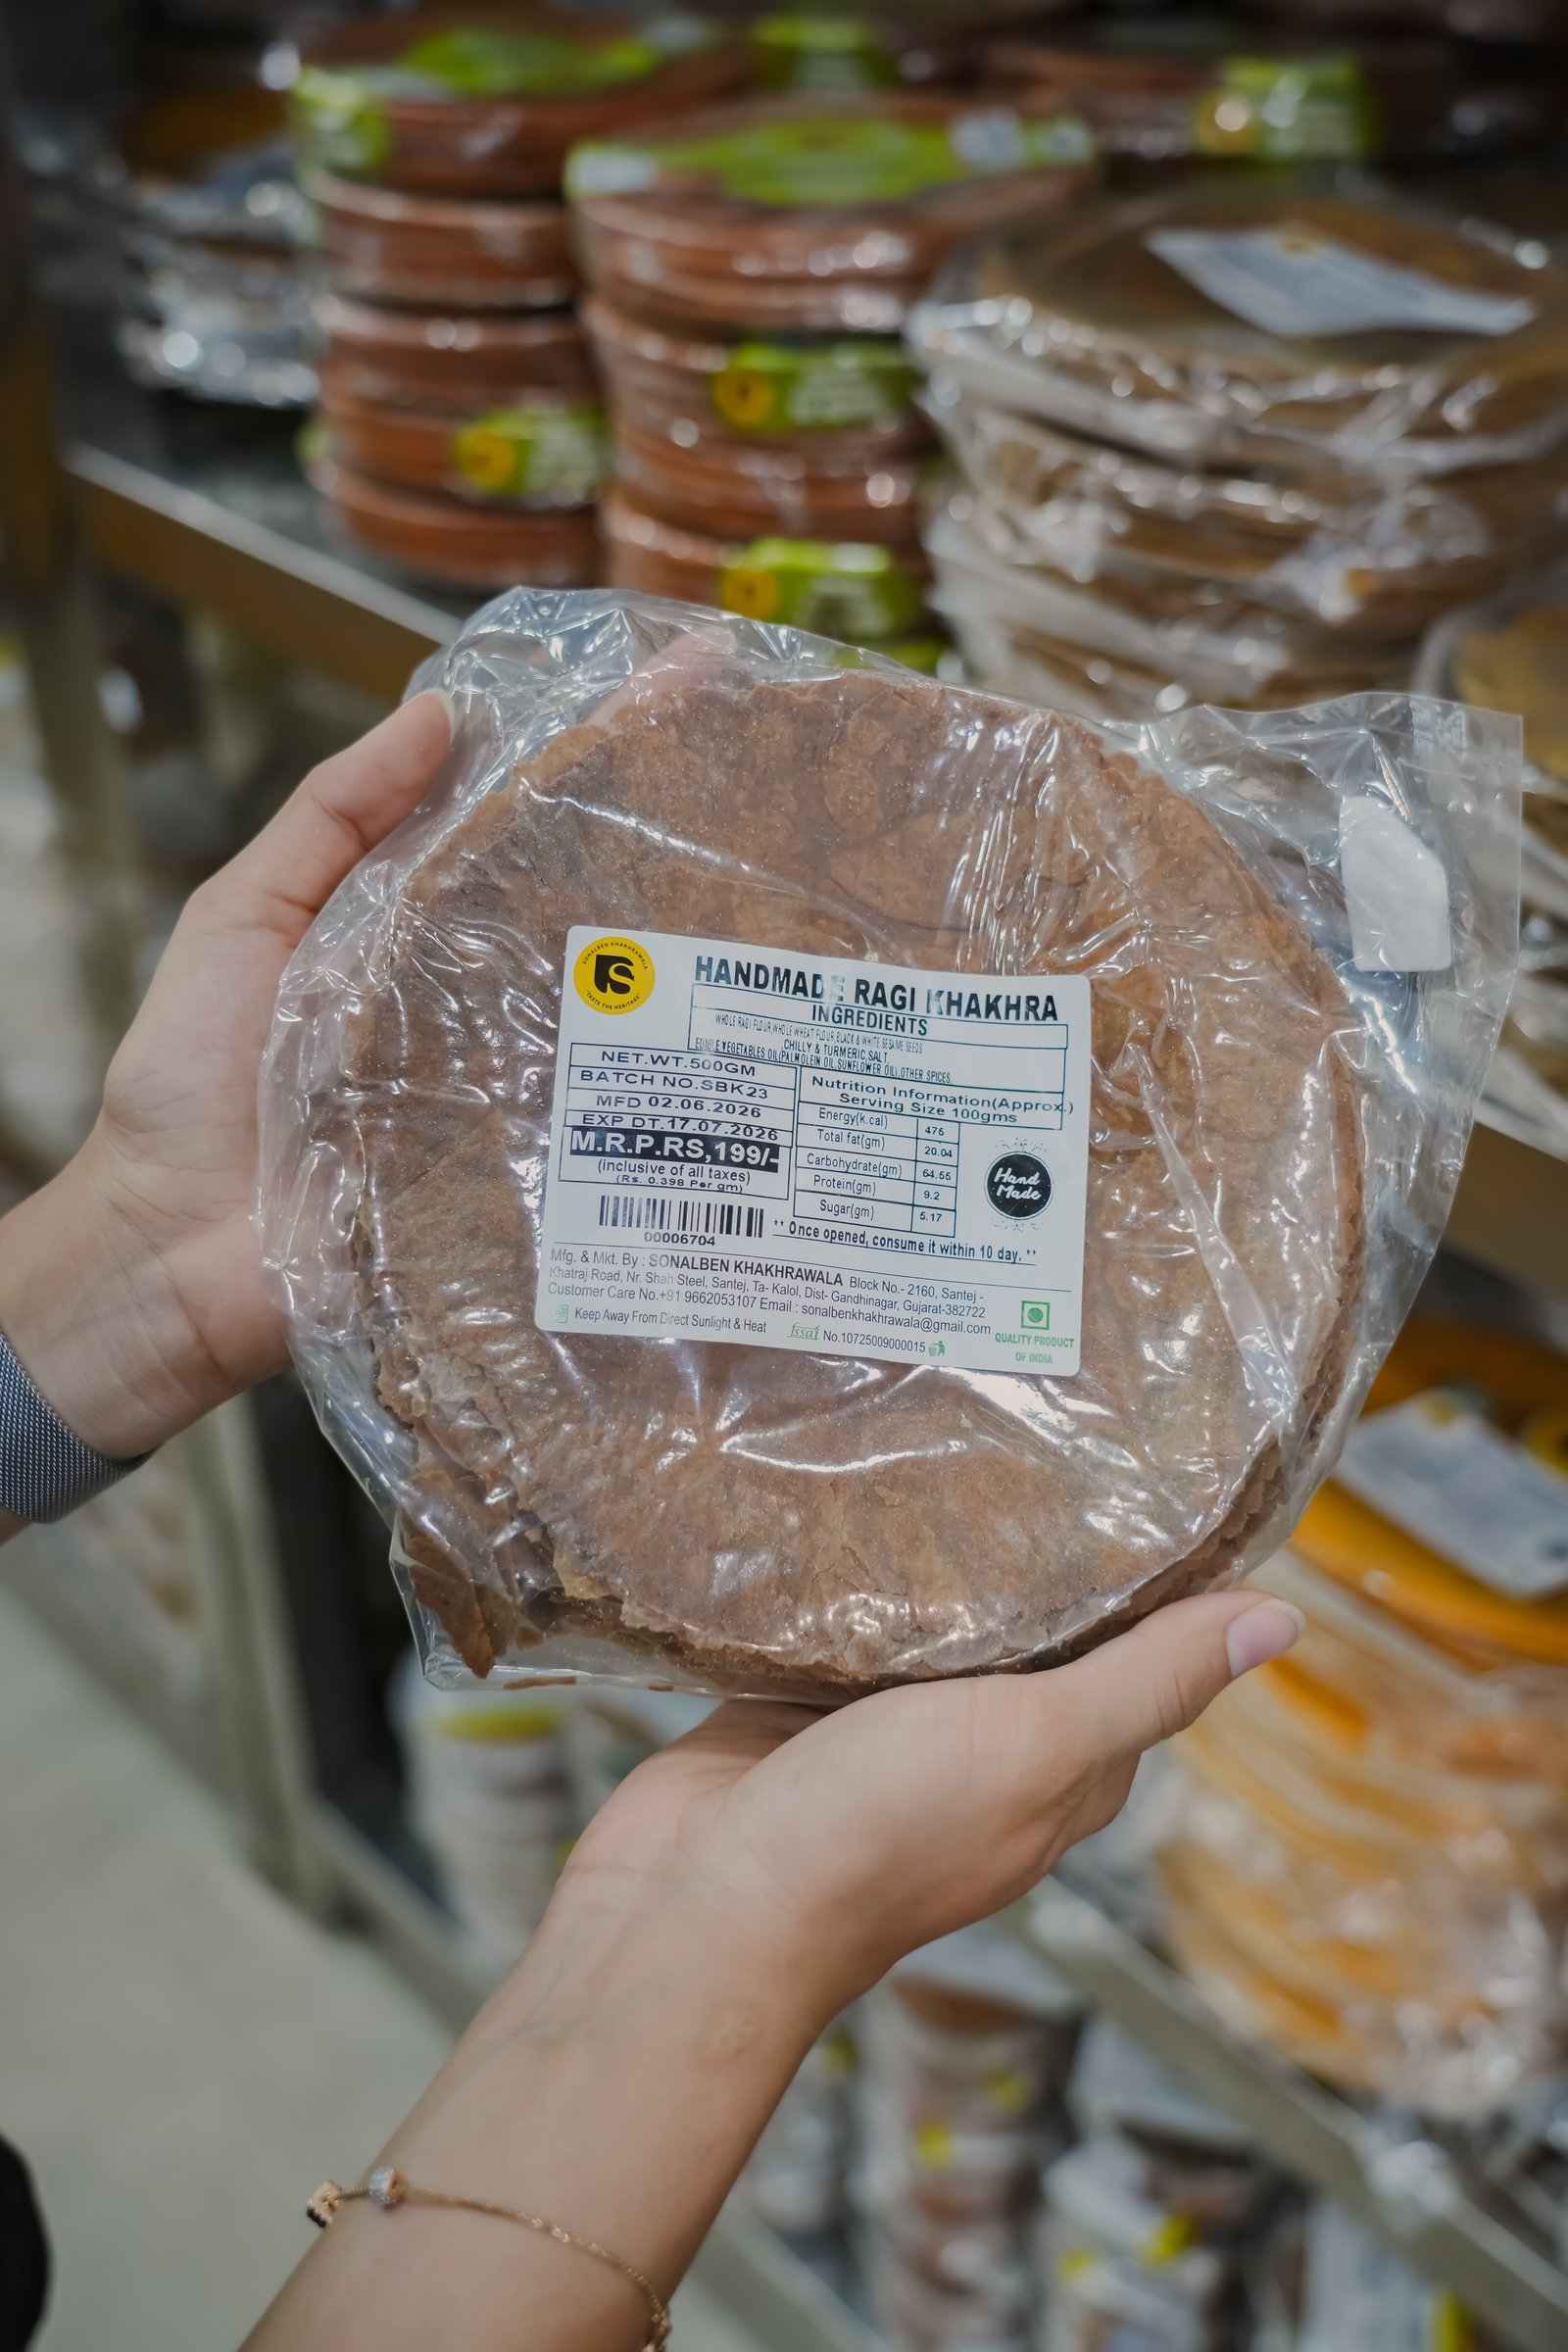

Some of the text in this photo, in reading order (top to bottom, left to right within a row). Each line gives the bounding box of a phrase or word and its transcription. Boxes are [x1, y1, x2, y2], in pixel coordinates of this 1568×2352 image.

[582, 942, 649, 970] SONALBEN KHAKHRAWALA
[695, 956, 1058, 1021] HANDMADE RAGI KHAKHRA
[812, 1004, 927, 1036] INGREDIENTS
[715, 1014, 736, 1026] WHOLE
[738, 1016, 752, 1029] RAGI
[794, 1027, 814, 1039] WHEAT
[862, 1036, 880, 1048] WHITE
[882, 1038, 904, 1052] SESAME
[906, 1041, 922, 1054] SEEDS
[695, 1037, 719, 1052] EDIBLE
[721, 1041, 765, 1058] VEGETABLES
[784, 1039, 812, 1054] CHILLY
[814, 1044, 820, 1054] &
[580, 1070, 655, 1086] BATCH
[812, 1075, 886, 1095] Nutrition
[596, 1095, 761, 1118] MFD 02.06.2026
[839, 1093, 1017, 1123] Serving Size 100gms
[582, 1113, 624, 1126] EXP
[817, 1129, 953, 1158] Total fat(gm) 20.04
[598, 1158, 751, 1186] (inclusive of all taxes)
[807, 1152, 903, 1179] Carbohydrate(gm)
[994, 1167, 1040, 1185] Hand
[616, 1175, 743, 1194] (Rs. 0.398 Per gm)
[813, 1174, 940, 1200] Protein(gm) 9.2
[997, 1184, 1042, 1200] Made
[819, 1199, 943, 1222] Sugar(gm) 5.17
[644, 1232, 715, 1247] 00006704
[789, 1220, 1021, 1264] Once opened, consume it within 10 day.
[551, 1248, 576, 1265] Mfg.
[580, 1250, 590, 1263] &
[593, 1250, 618, 1265] Mkt.
[622, 1252, 639, 1269] By
[649, 1253, 730, 1273] SONALBEN
[734, 1260, 843, 1287] KHAKHRAWALA
[849, 1276, 879, 1293] Block
[907, 1283, 938, 1299] 2160,
[942, 1287, 976, 1303] Santej
[549, 1266, 986, 1319] Khatraj Road, Nr. Shah Steel, Santej, Ta- Kalol, Dist- Gandhinagar, Gujarat-382722
[548, 1282, 604, 1298] Customer
[608, 1286, 635, 1299] Care
[684, 1290, 757, 1309] 9662053107
[760, 1298, 792, 1312] Email
[802, 1303, 991, 1336] sonalbenkhakhrawala@gmail.com
[575, 1306, 766, 1333] Keep Away From Direct Sunlight & Heat
[823, 1330, 926, 1352] No.10725009000015
[995, 1331, 1075, 1348] QUALITY PRODUCT
[1015, 1350, 1053, 1364] OF INDIA
